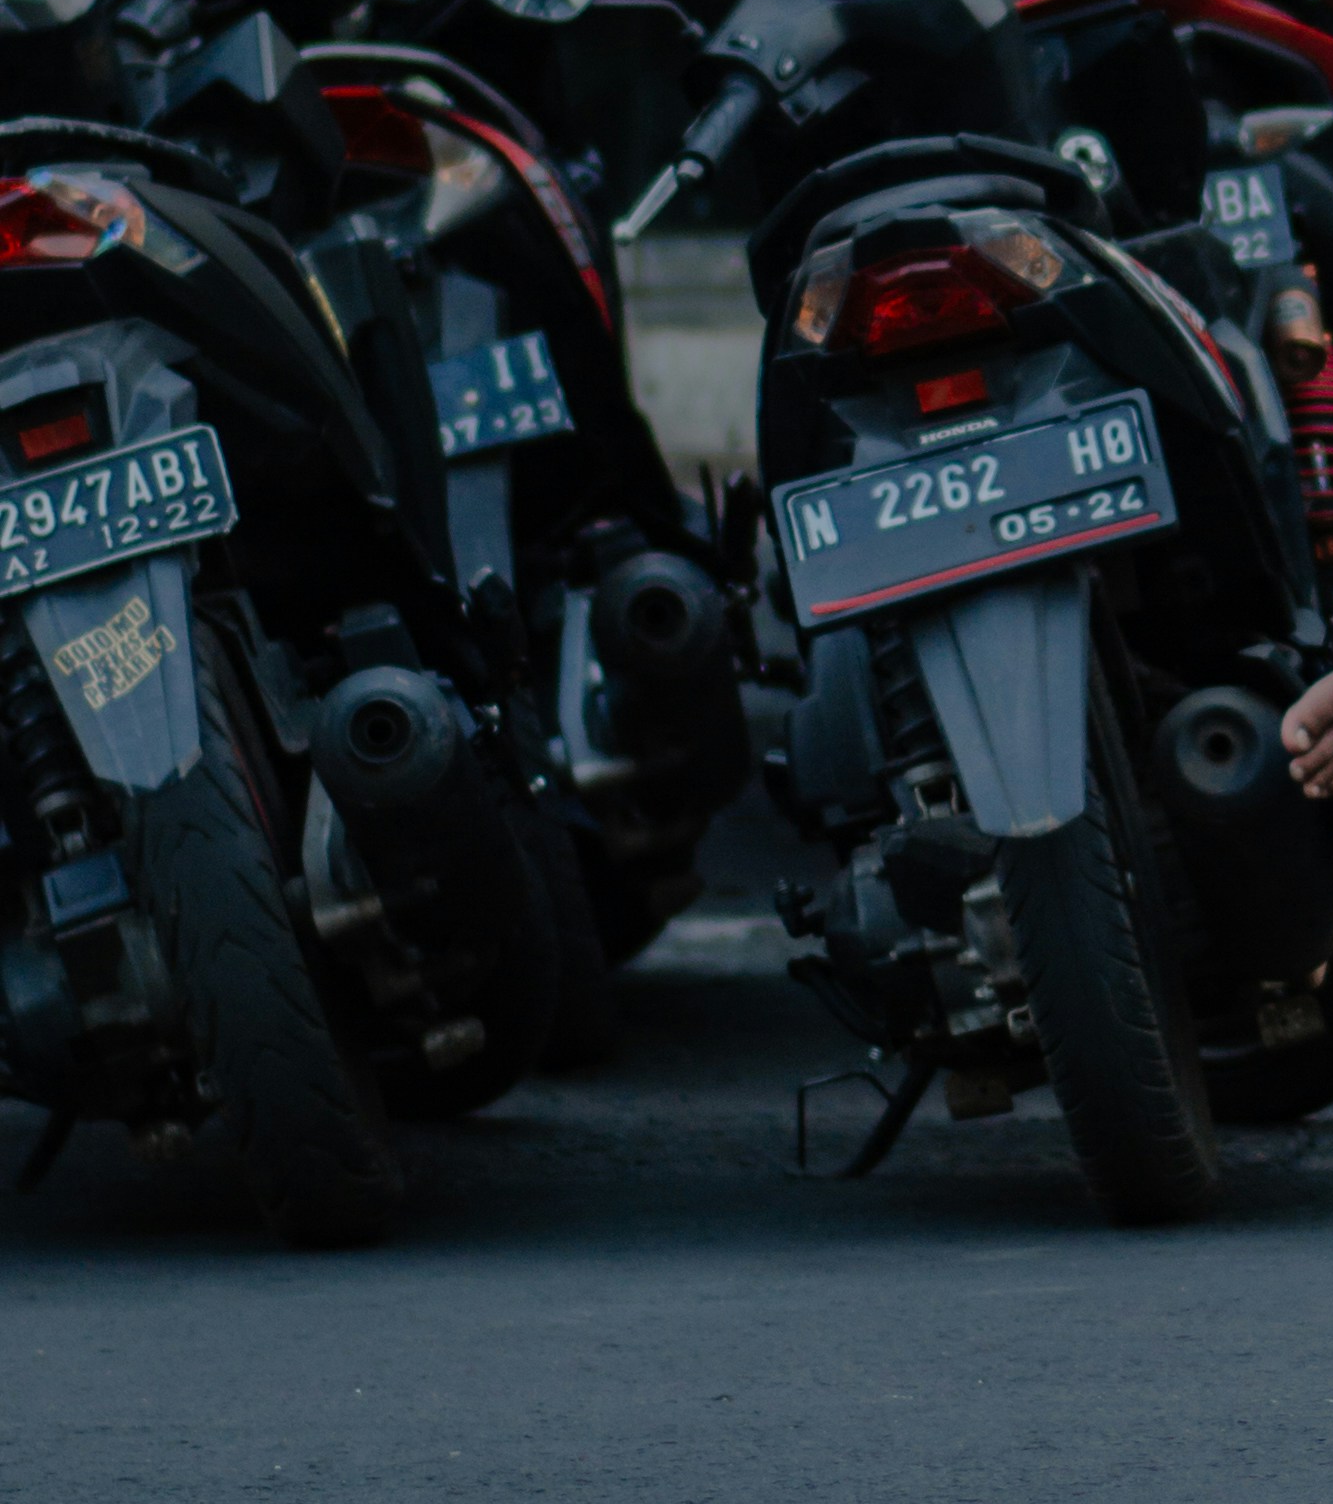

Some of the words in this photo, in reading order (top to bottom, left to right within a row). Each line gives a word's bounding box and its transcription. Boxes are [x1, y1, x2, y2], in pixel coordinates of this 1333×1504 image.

[1216, 175, 1273, 224] BA
[918, 417, 999, 445] HONDA
[801, 498, 840, 551] N
[871, 454, 1006, 530] 2262
